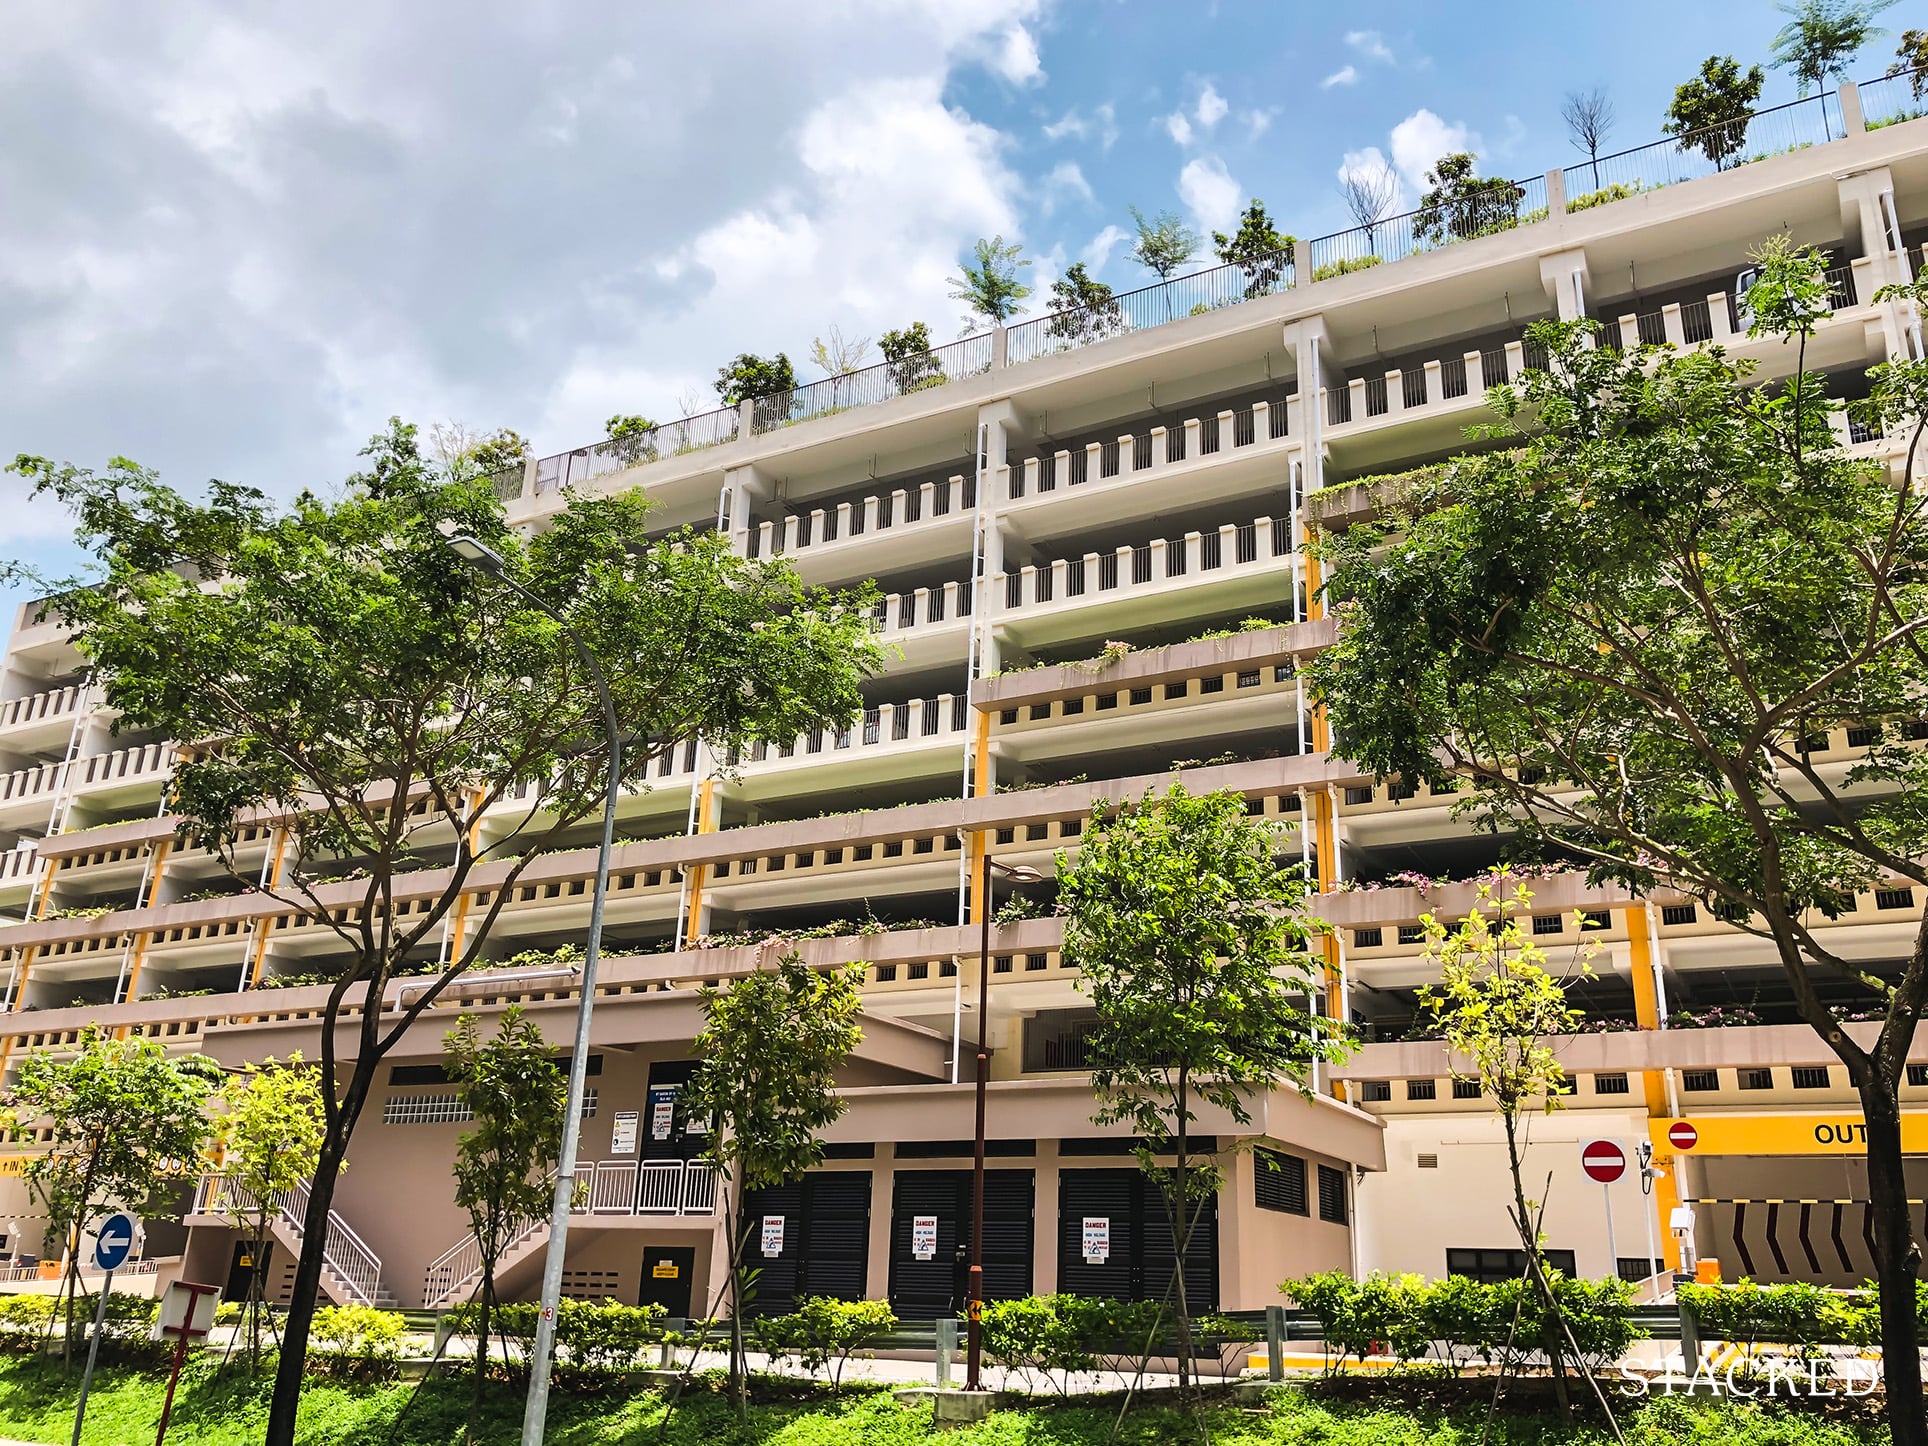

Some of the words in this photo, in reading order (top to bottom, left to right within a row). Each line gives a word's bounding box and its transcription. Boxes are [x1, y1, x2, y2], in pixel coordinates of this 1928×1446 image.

[1814, 1124, 1868, 1144] OUT
[9, 1161, 20, 1171] IN
[546, 1307, 553, 1320] 3
